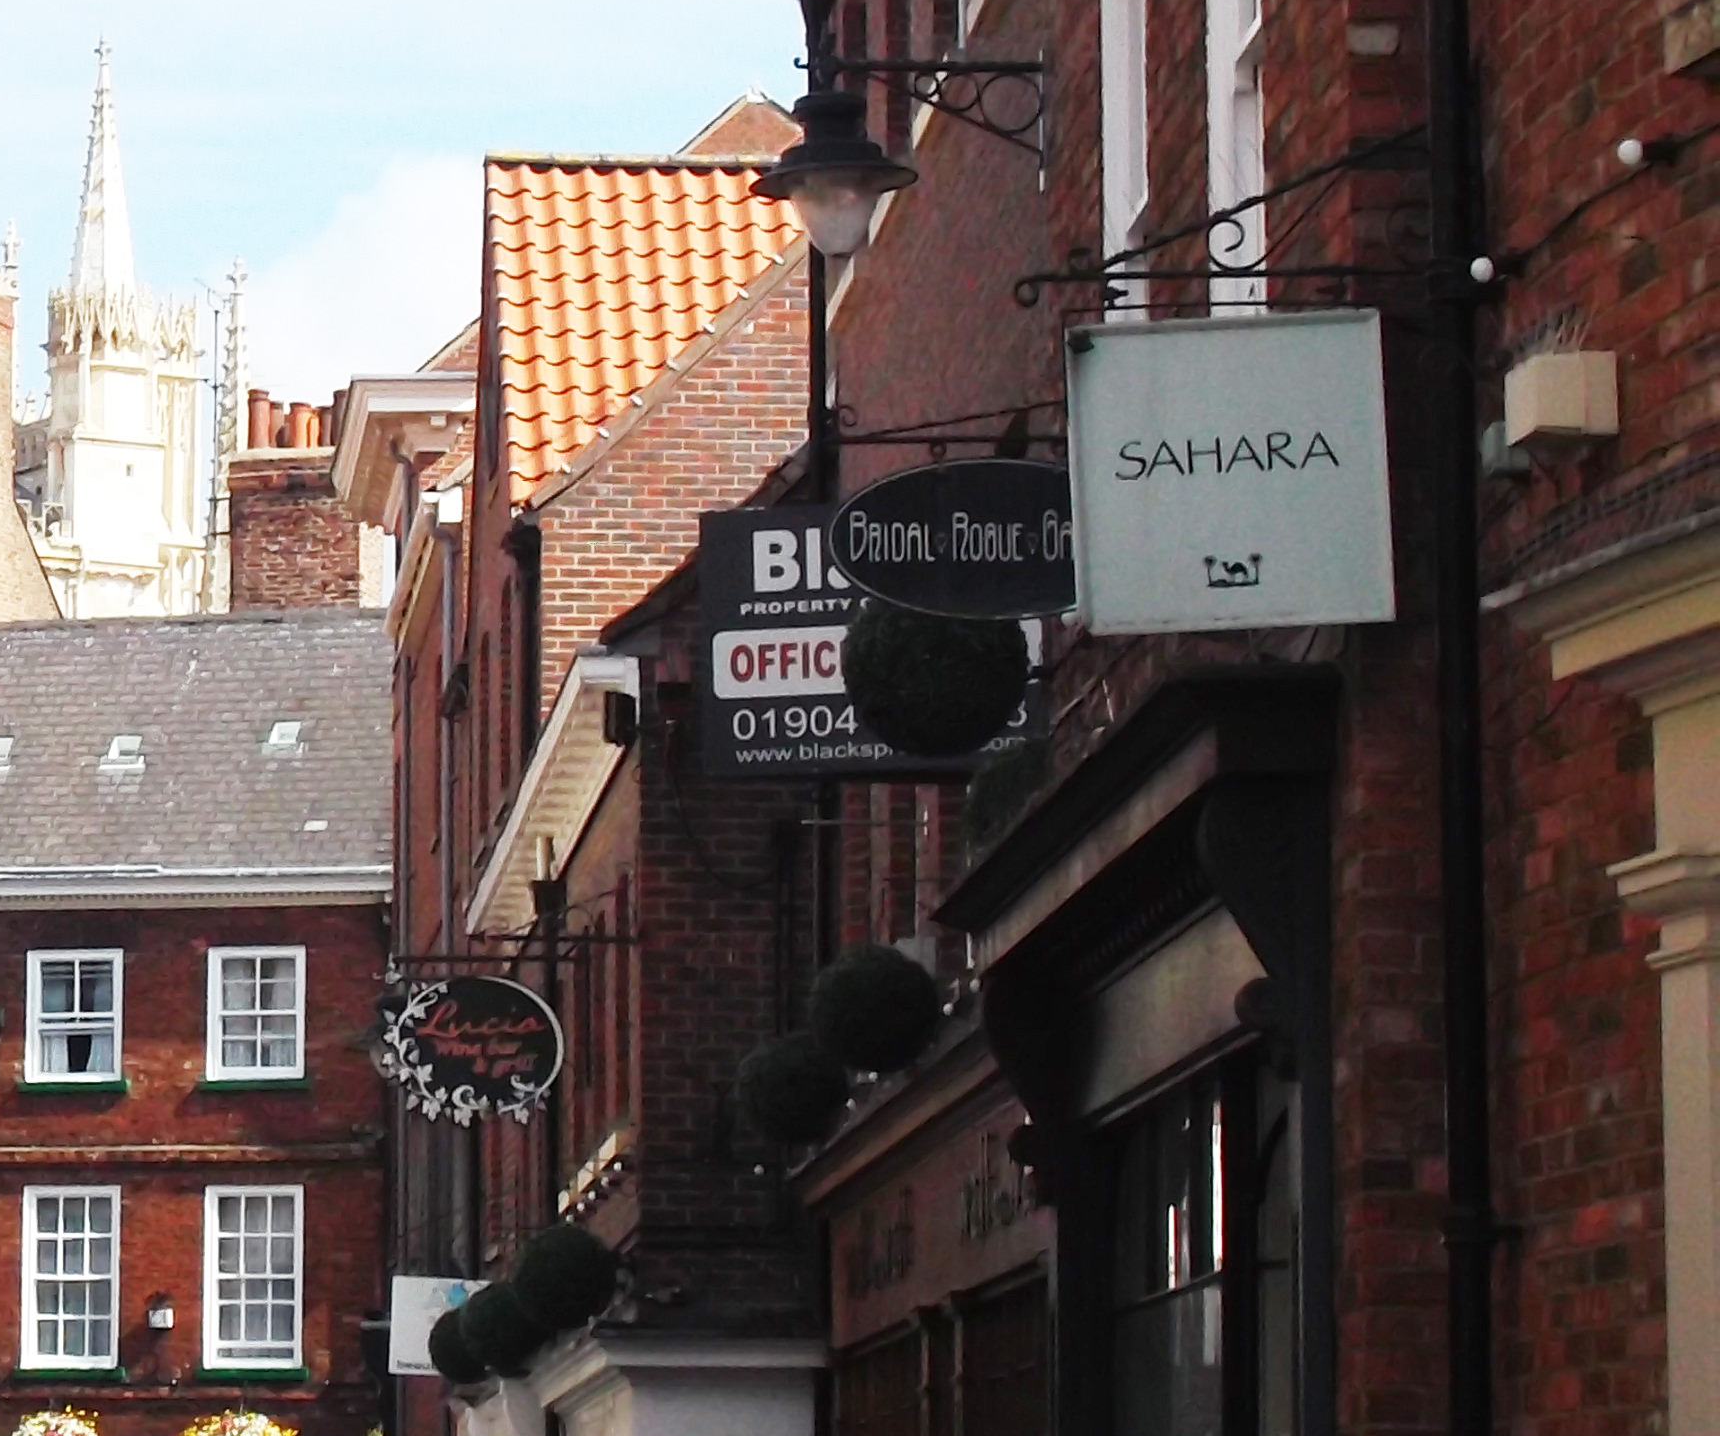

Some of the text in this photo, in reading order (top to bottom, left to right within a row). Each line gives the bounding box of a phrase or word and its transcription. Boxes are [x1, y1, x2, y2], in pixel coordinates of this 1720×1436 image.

[1115, 430, 1340, 481] SAHARA
[739, 597, 853, 616] PROPERTY
[729, 639, 846, 683] OFFIC
[732, 705, 859, 741] 01904
